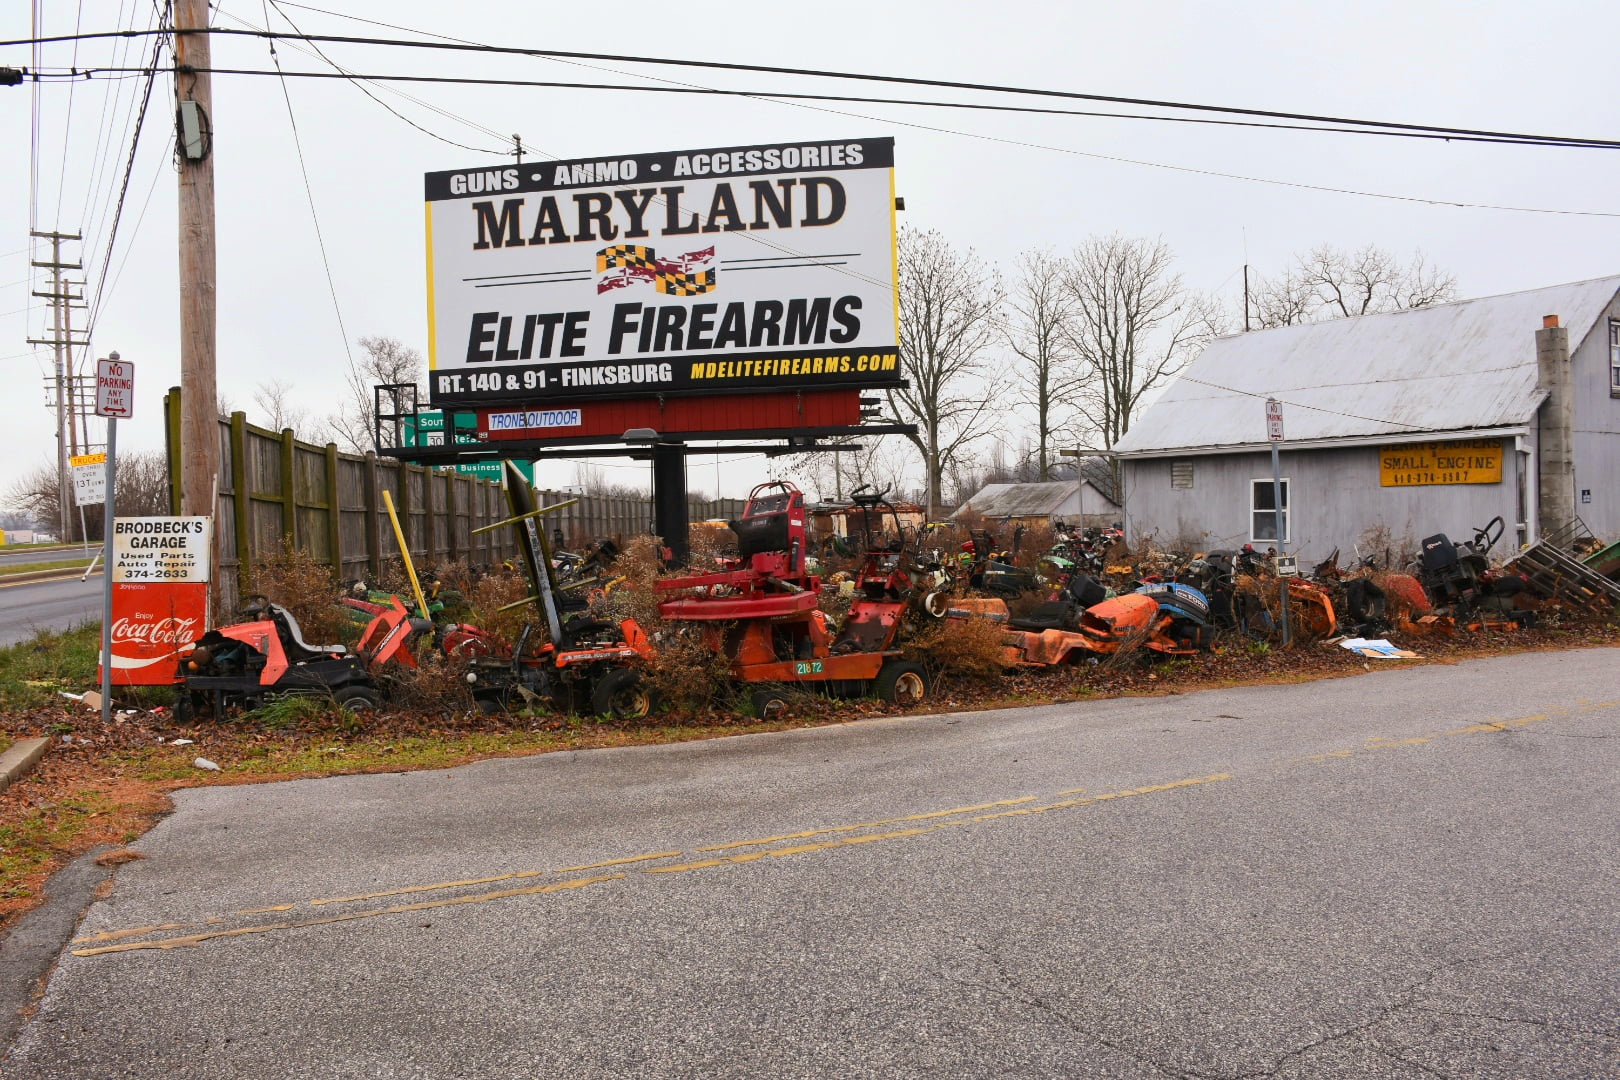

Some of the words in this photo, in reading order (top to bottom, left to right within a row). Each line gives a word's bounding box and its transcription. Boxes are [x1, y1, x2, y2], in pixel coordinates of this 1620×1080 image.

[450, 168, 520, 195] GUNS
[553, 159, 638, 186] AMMO
[673, 143, 864, 177] ACCESSORIES
[472, 175, 847, 250] MARYLAND
[466, 310, 590, 363] ELITE
[607, 295, 862, 355] FIREARMS
[109, 365, 123, 376] NO
[690, 354, 897, 380] MDELITEFIREARMS.COM
[99, 377, 131, 389] PARKING
[438, 374, 465, 394] RT.
[468, 373, 501, 392] 140
[506, 375, 520, 390] &
[523, 370, 546, 389] 91
[561, 363, 673, 387] FINKSBURG
[108, 390, 122, 398] ANY
[106, 398, 123, 406] TIME
[420, 418, 443, 427] SOUT
[491, 414, 525, 429] TRONE
[527, 410, 578, 427] OUTDOOR
[74, 455, 101, 465] TRUCKS
[1383, 456, 1429, 470] SMALL
[1437, 456, 1495, 469] ENGINE
[115, 521, 203, 534] BRODBECK'S
[130, 536, 187, 549] GARAGE
[154, 560, 196, 569] Repair
[124, 570, 188, 578] 374-2633
[135, 612, 154, 620] Enjoy
[110, 617, 199, 643] Coca-Cola
